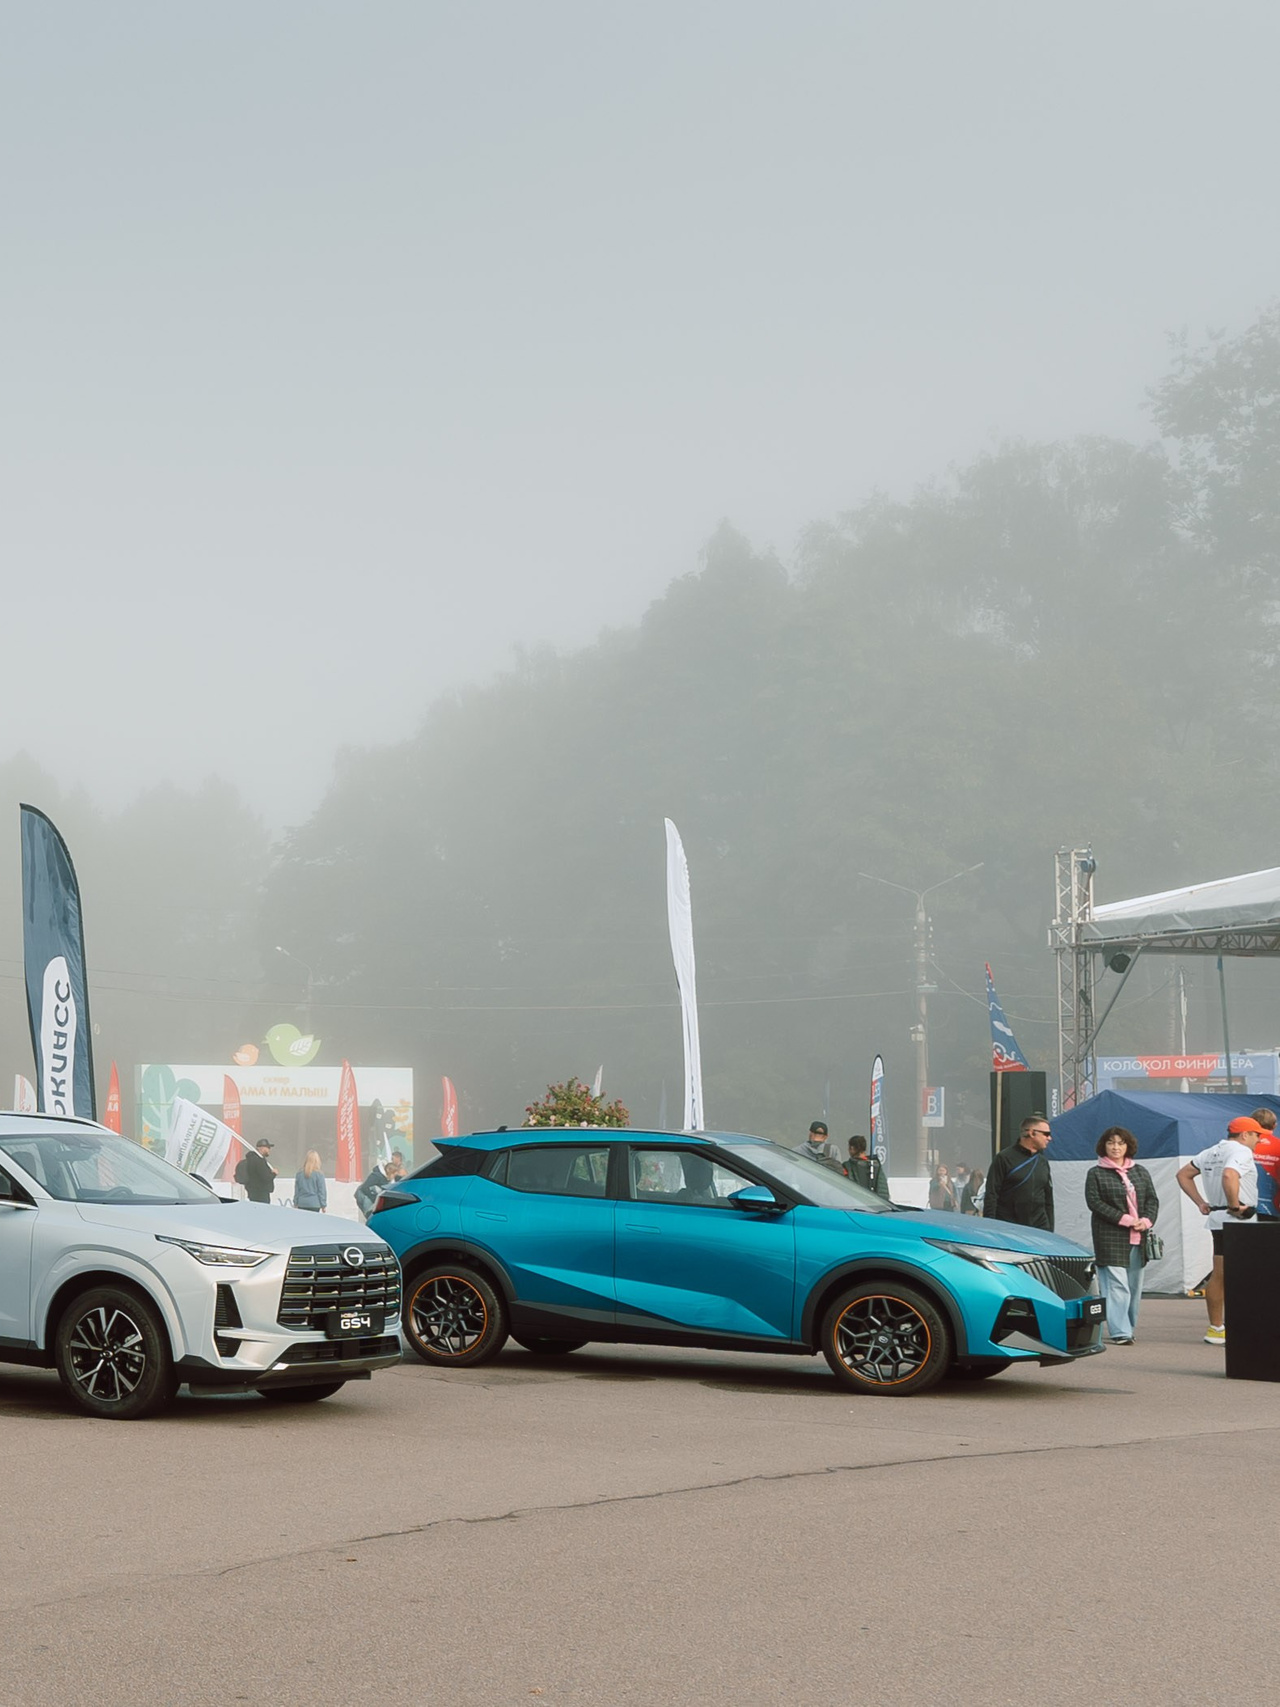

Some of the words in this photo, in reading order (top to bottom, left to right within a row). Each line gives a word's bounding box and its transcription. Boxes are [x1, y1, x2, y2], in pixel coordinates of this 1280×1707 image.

[1103, 1060, 1171, 1072] КОЛОКОЛ
[240, 1086, 266, 1098] АМА
[268, 1086, 278, 1098] И
[280, 1086, 328, 1098] МАЛЫШ
[340, 1316, 371, 1330] GS4
